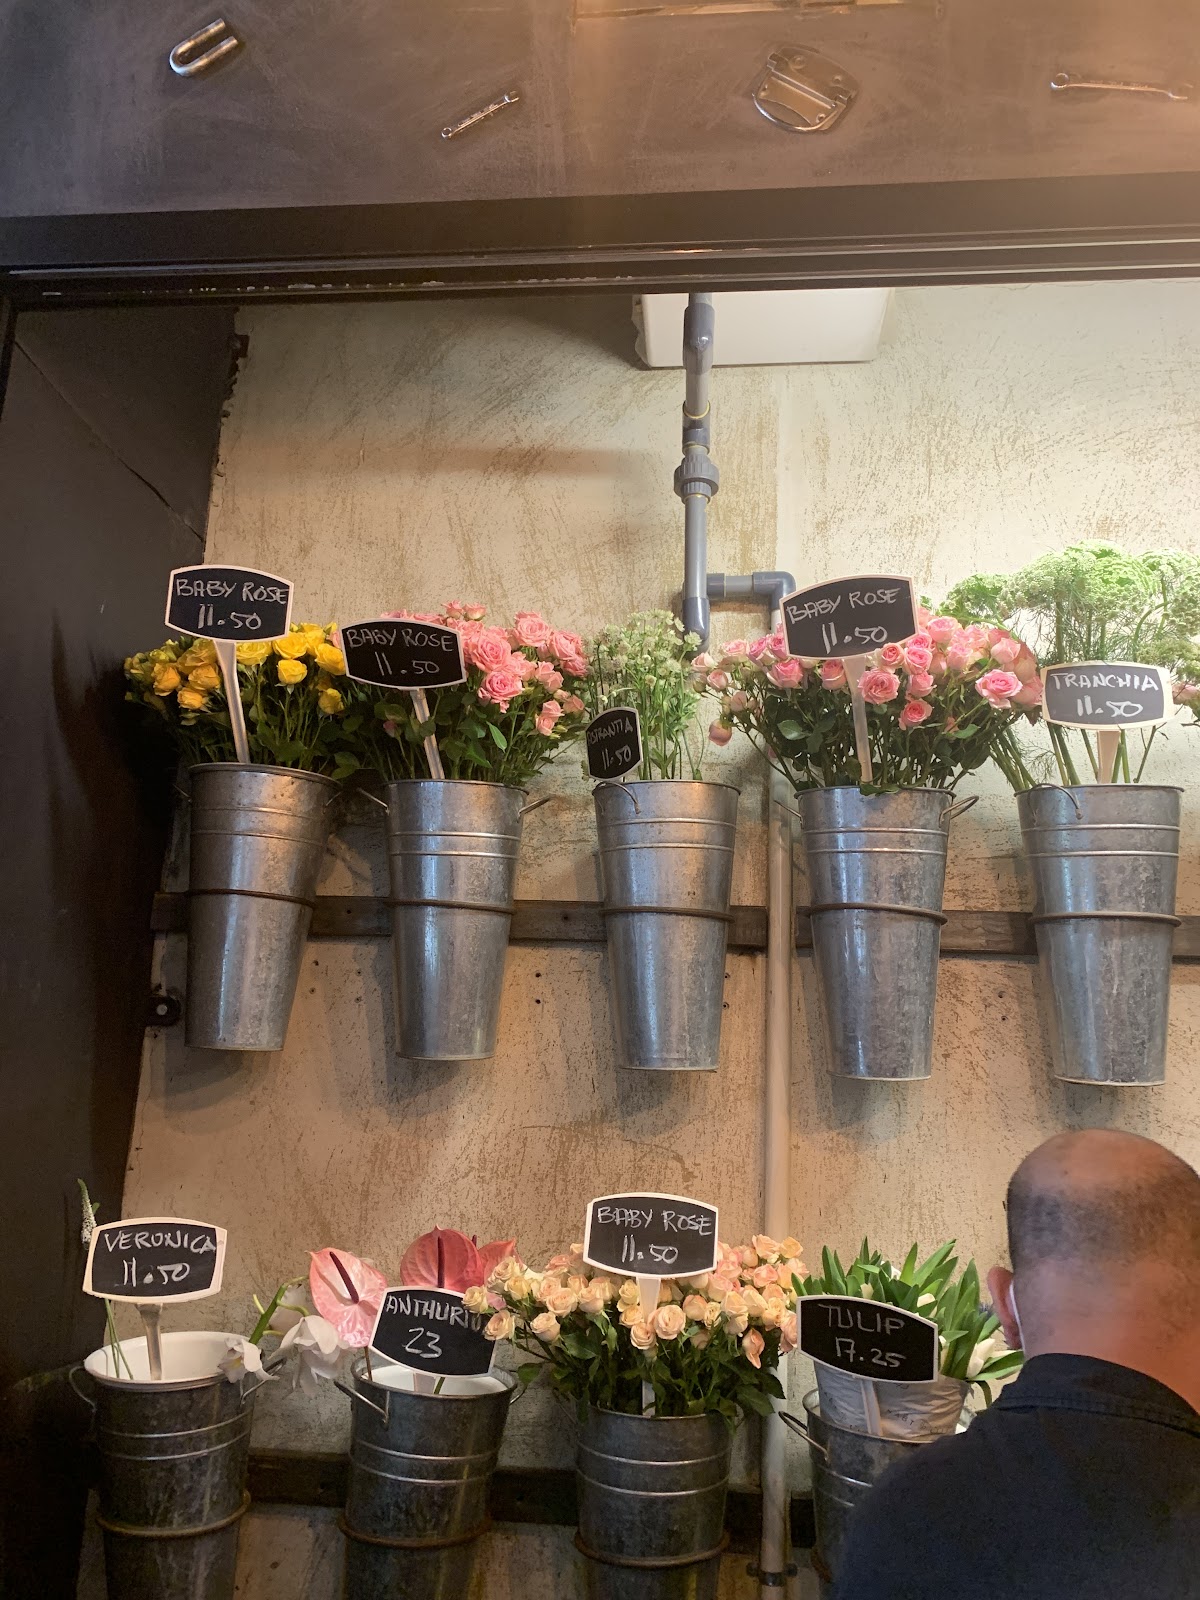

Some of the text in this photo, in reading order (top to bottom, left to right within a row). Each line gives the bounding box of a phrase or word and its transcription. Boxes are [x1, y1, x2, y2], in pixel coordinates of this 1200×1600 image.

[176, 578, 290, 604] BABY ROSE
[786, 587, 901, 625] BABY ROSE
[198, 603, 262, 630] 11.50
[346, 628, 454, 652] BABY ROSE
[822, 622, 888, 655] 11.50
[374, 651, 440, 677] 11.50
[1076, 694, 1144, 718] 11.50
[601, 744, 632, 771] 11.50
[597, 1206, 712, 1236] BABY ROSE
[104, 1230, 217, 1254] VERONICA
[621, 1234, 679, 1265] 11.50
[122, 1256, 190, 1288] 11.50
[818, 1303, 905, 1335] TULIP
[403, 1327, 443, 1359] 23
[835, 1336, 907, 1368] 17.25
